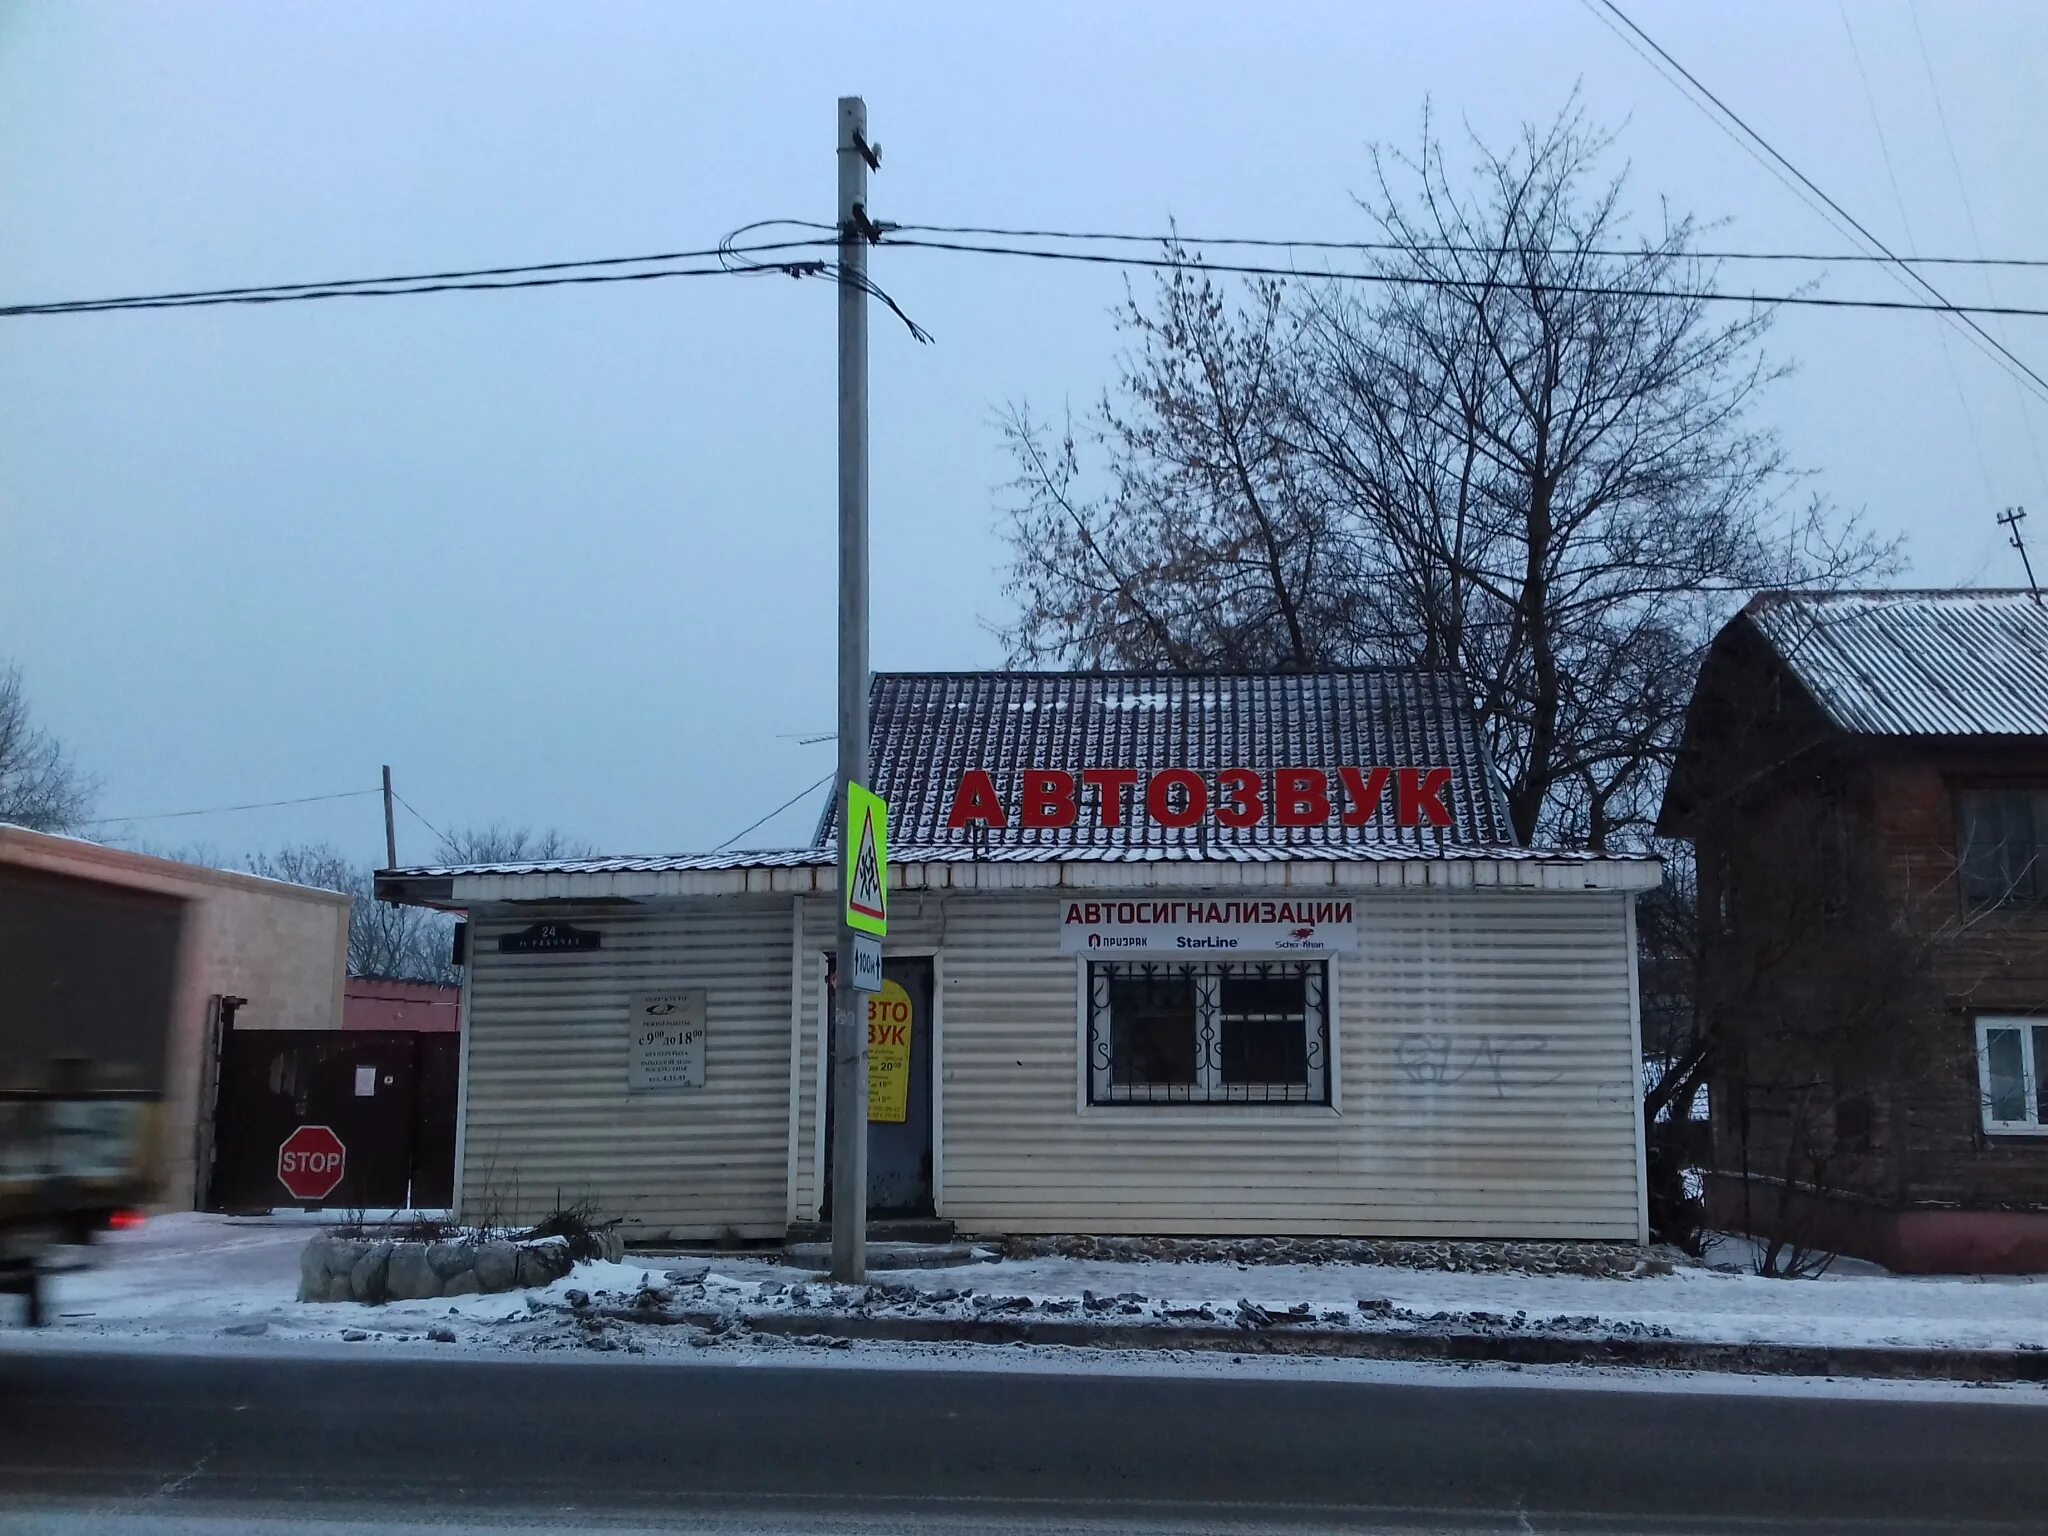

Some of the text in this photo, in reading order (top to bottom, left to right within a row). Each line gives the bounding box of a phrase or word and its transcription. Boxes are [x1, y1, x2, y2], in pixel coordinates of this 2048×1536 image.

[947, 767, 1454, 828] АВТОЗВУК
[1065, 902, 1353, 926] АВТОСИГНАЛИЗАЦИИ
[542, 926, 556, 937] 24
[1176, 936, 1238, 948] StarLine
[868, 1001, 908, 1022] ВТО
[868, 1024, 906, 1046] ВУК
[282, 1152, 341, 1173] STOP
